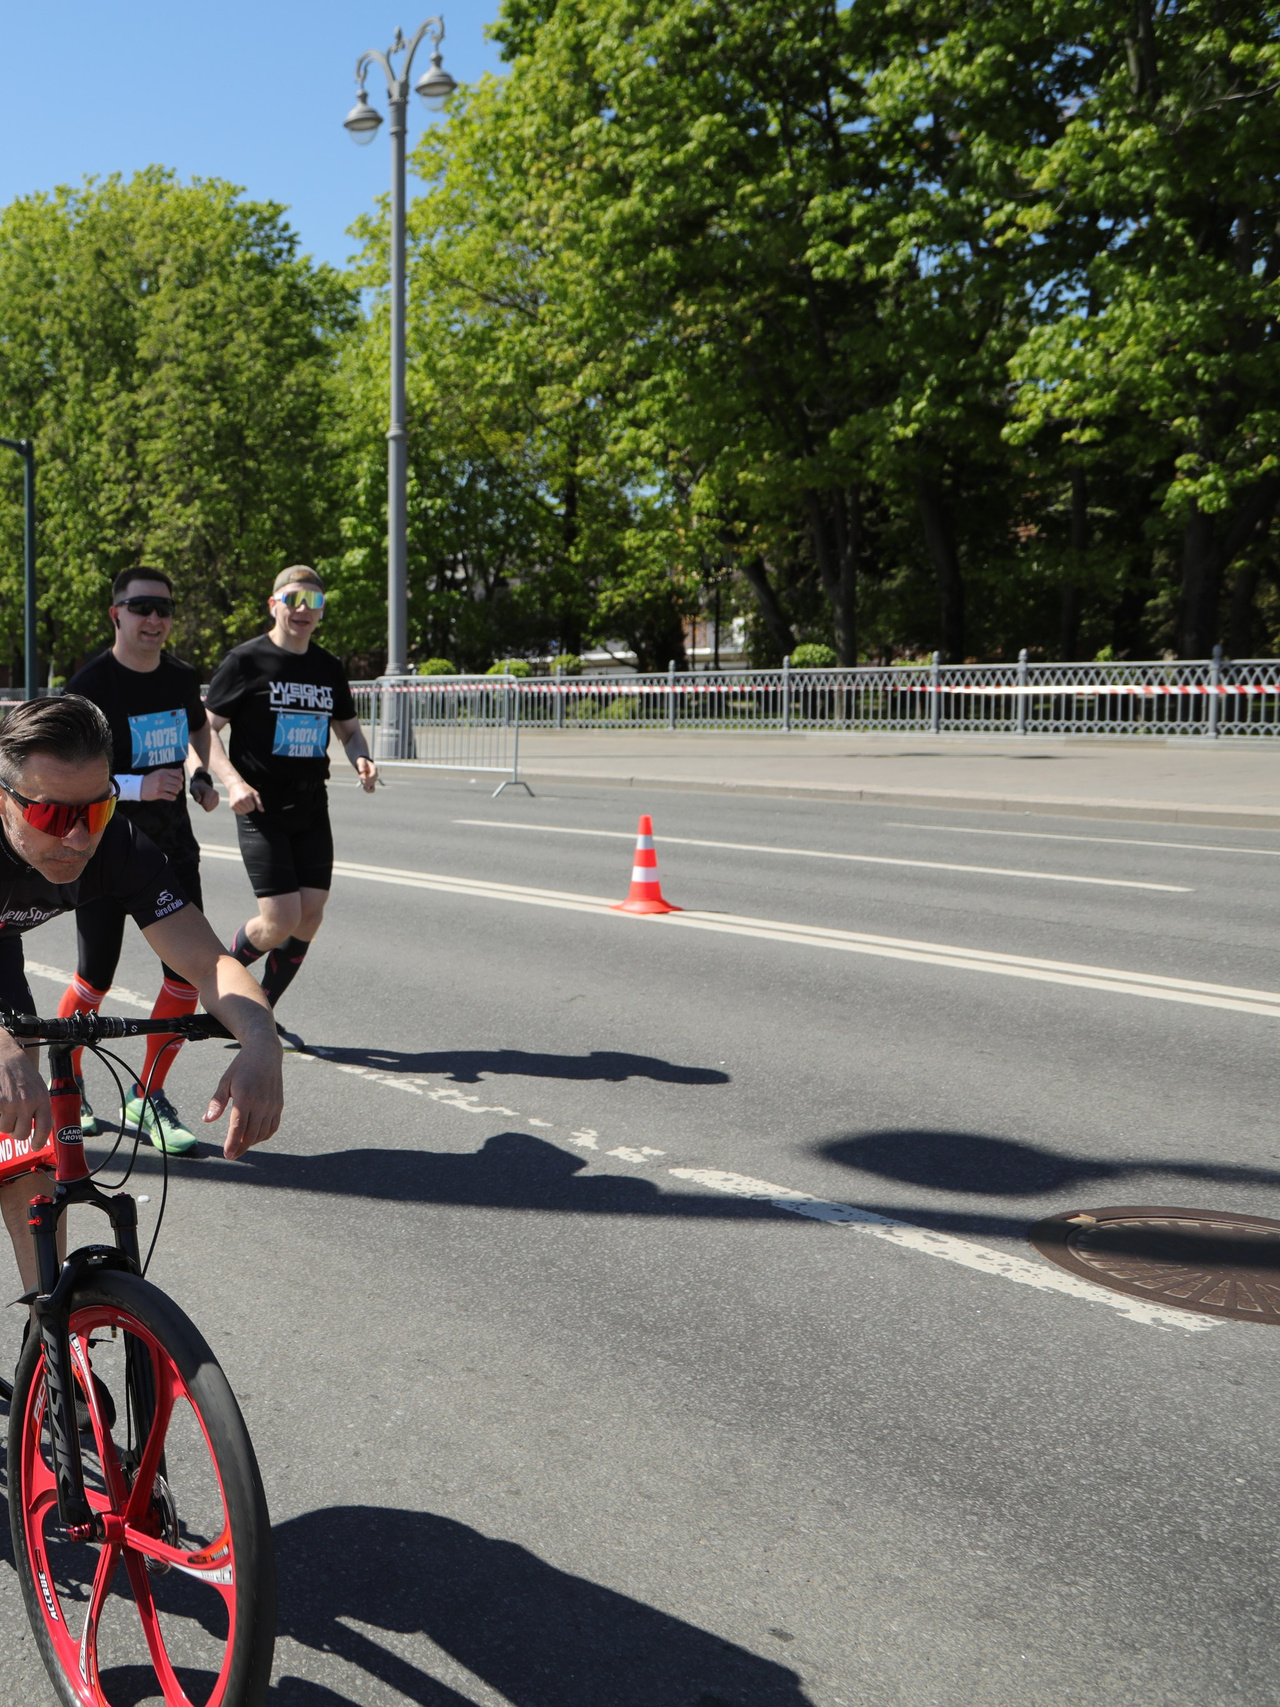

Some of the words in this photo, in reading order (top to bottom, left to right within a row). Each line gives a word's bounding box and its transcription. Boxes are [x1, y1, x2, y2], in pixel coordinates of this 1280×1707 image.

[270, 681, 332, 698] WEIGHT
[270, 693, 333, 710] LIFTING
[144, 726, 178, 749] 41075
[286, 727, 318, 744] 41074
[64, 1133, 83, 1141] ROVE
[41, 1326, 75, 1487] PASAK
[38, 1571, 59, 1622] ACCRUE
